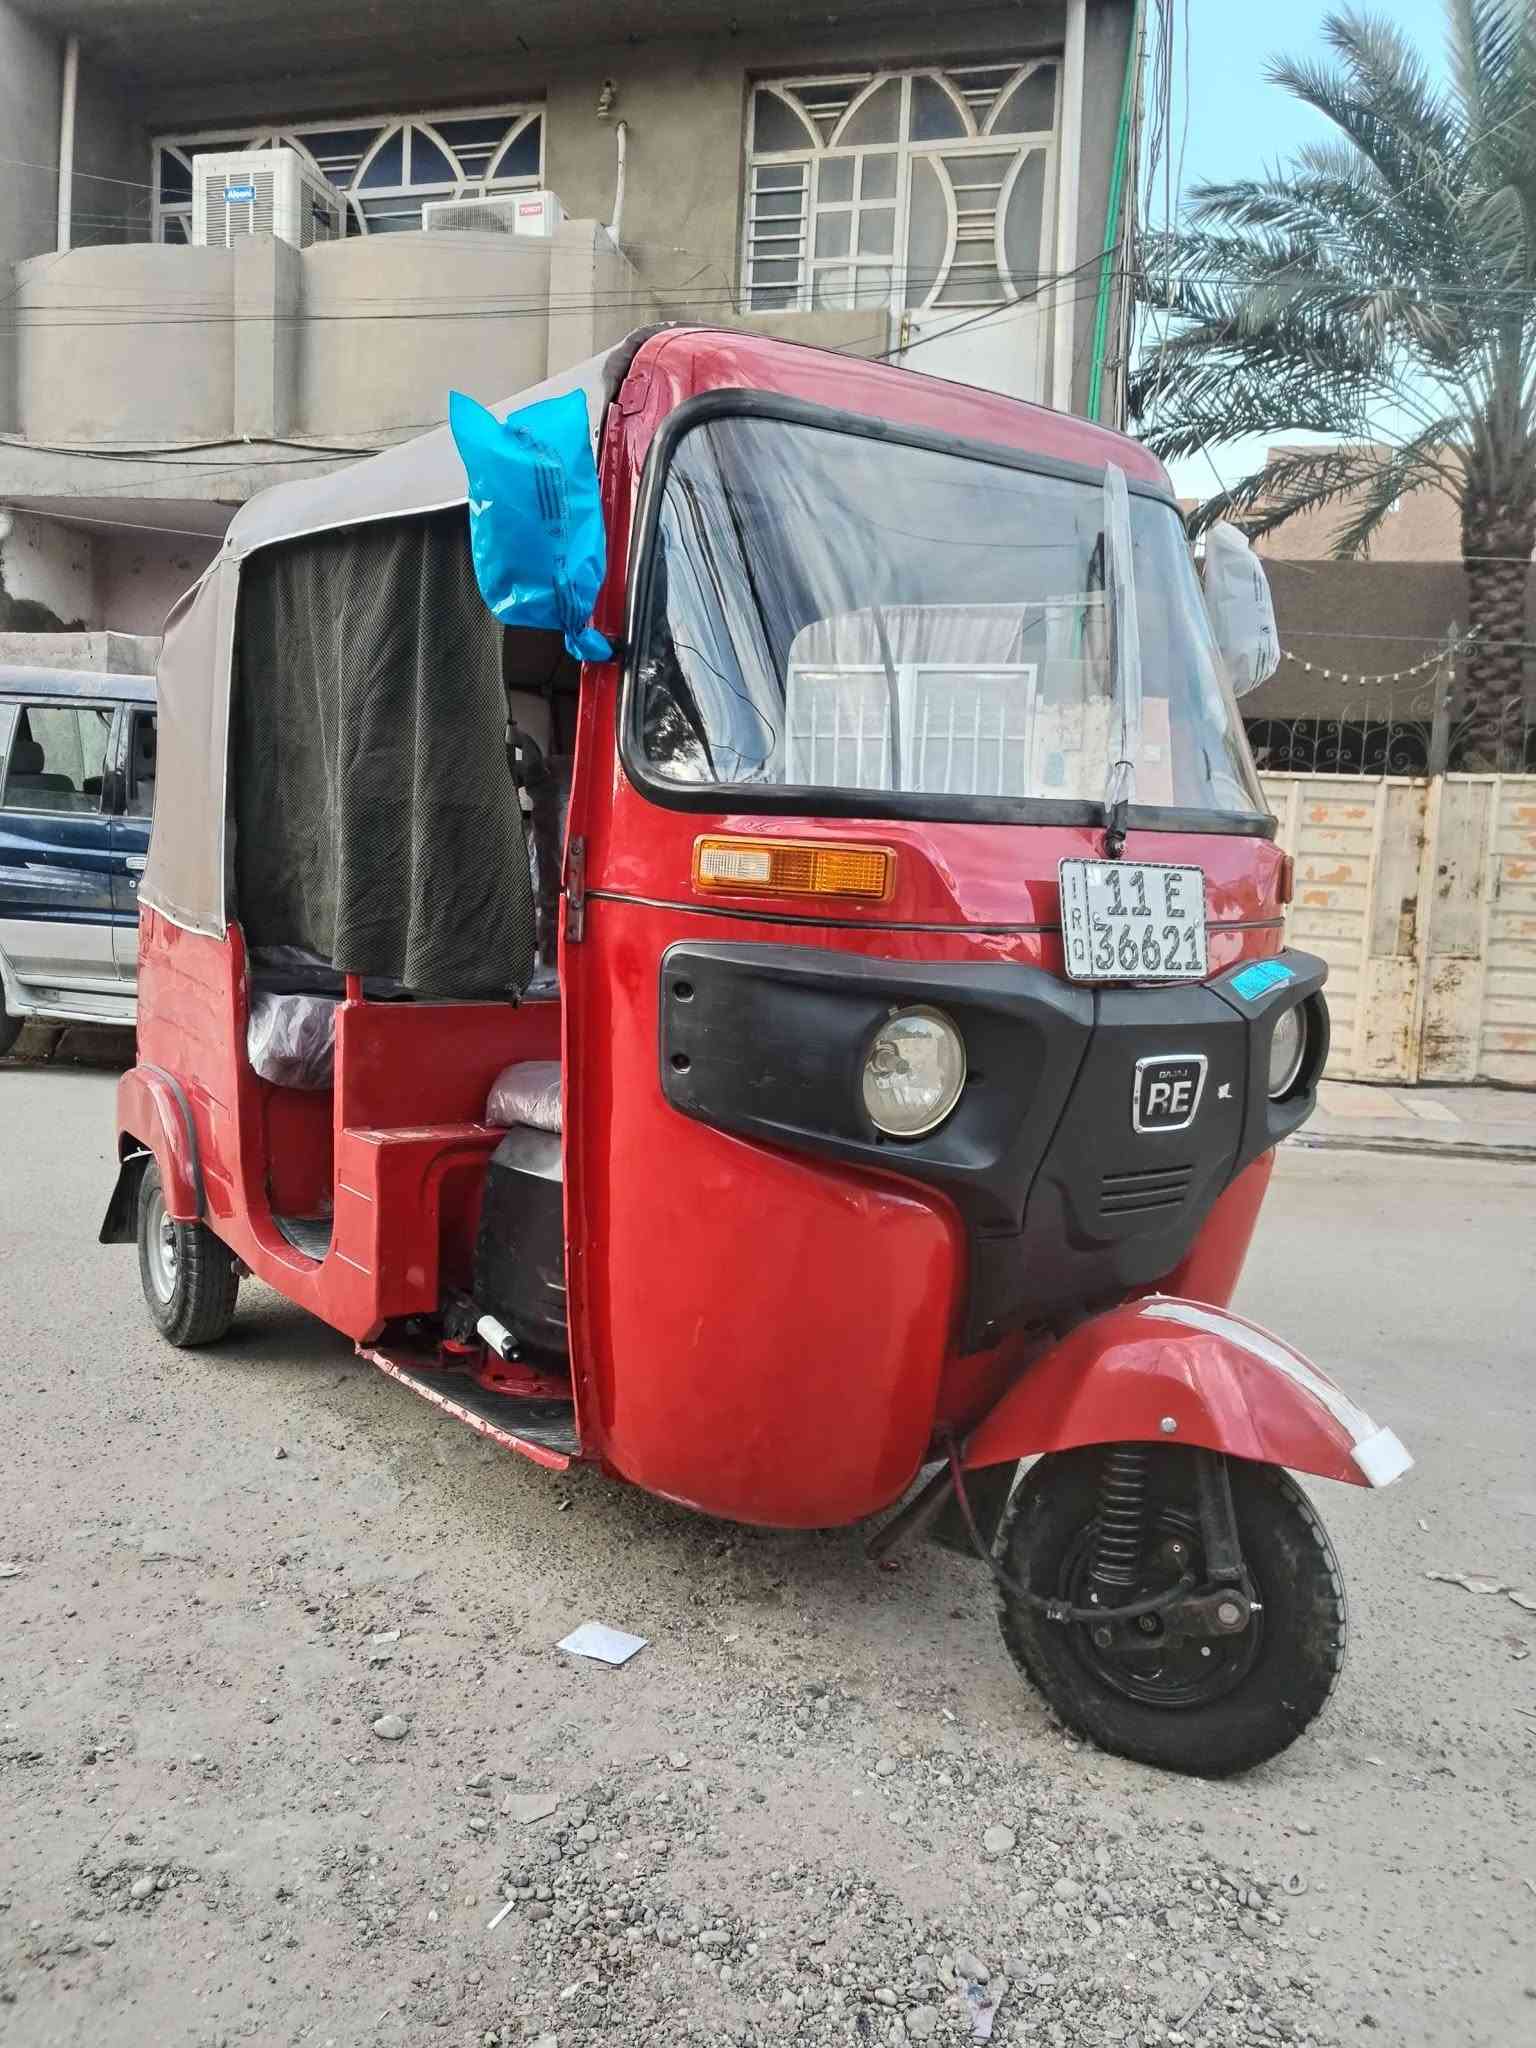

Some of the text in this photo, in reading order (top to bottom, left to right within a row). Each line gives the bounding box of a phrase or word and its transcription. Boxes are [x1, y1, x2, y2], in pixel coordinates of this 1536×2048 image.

[1104, 869, 1185, 918] 11 E
[1094, 922, 1202, 971] 36621
[1146, 1080, 1192, 1116] RE
